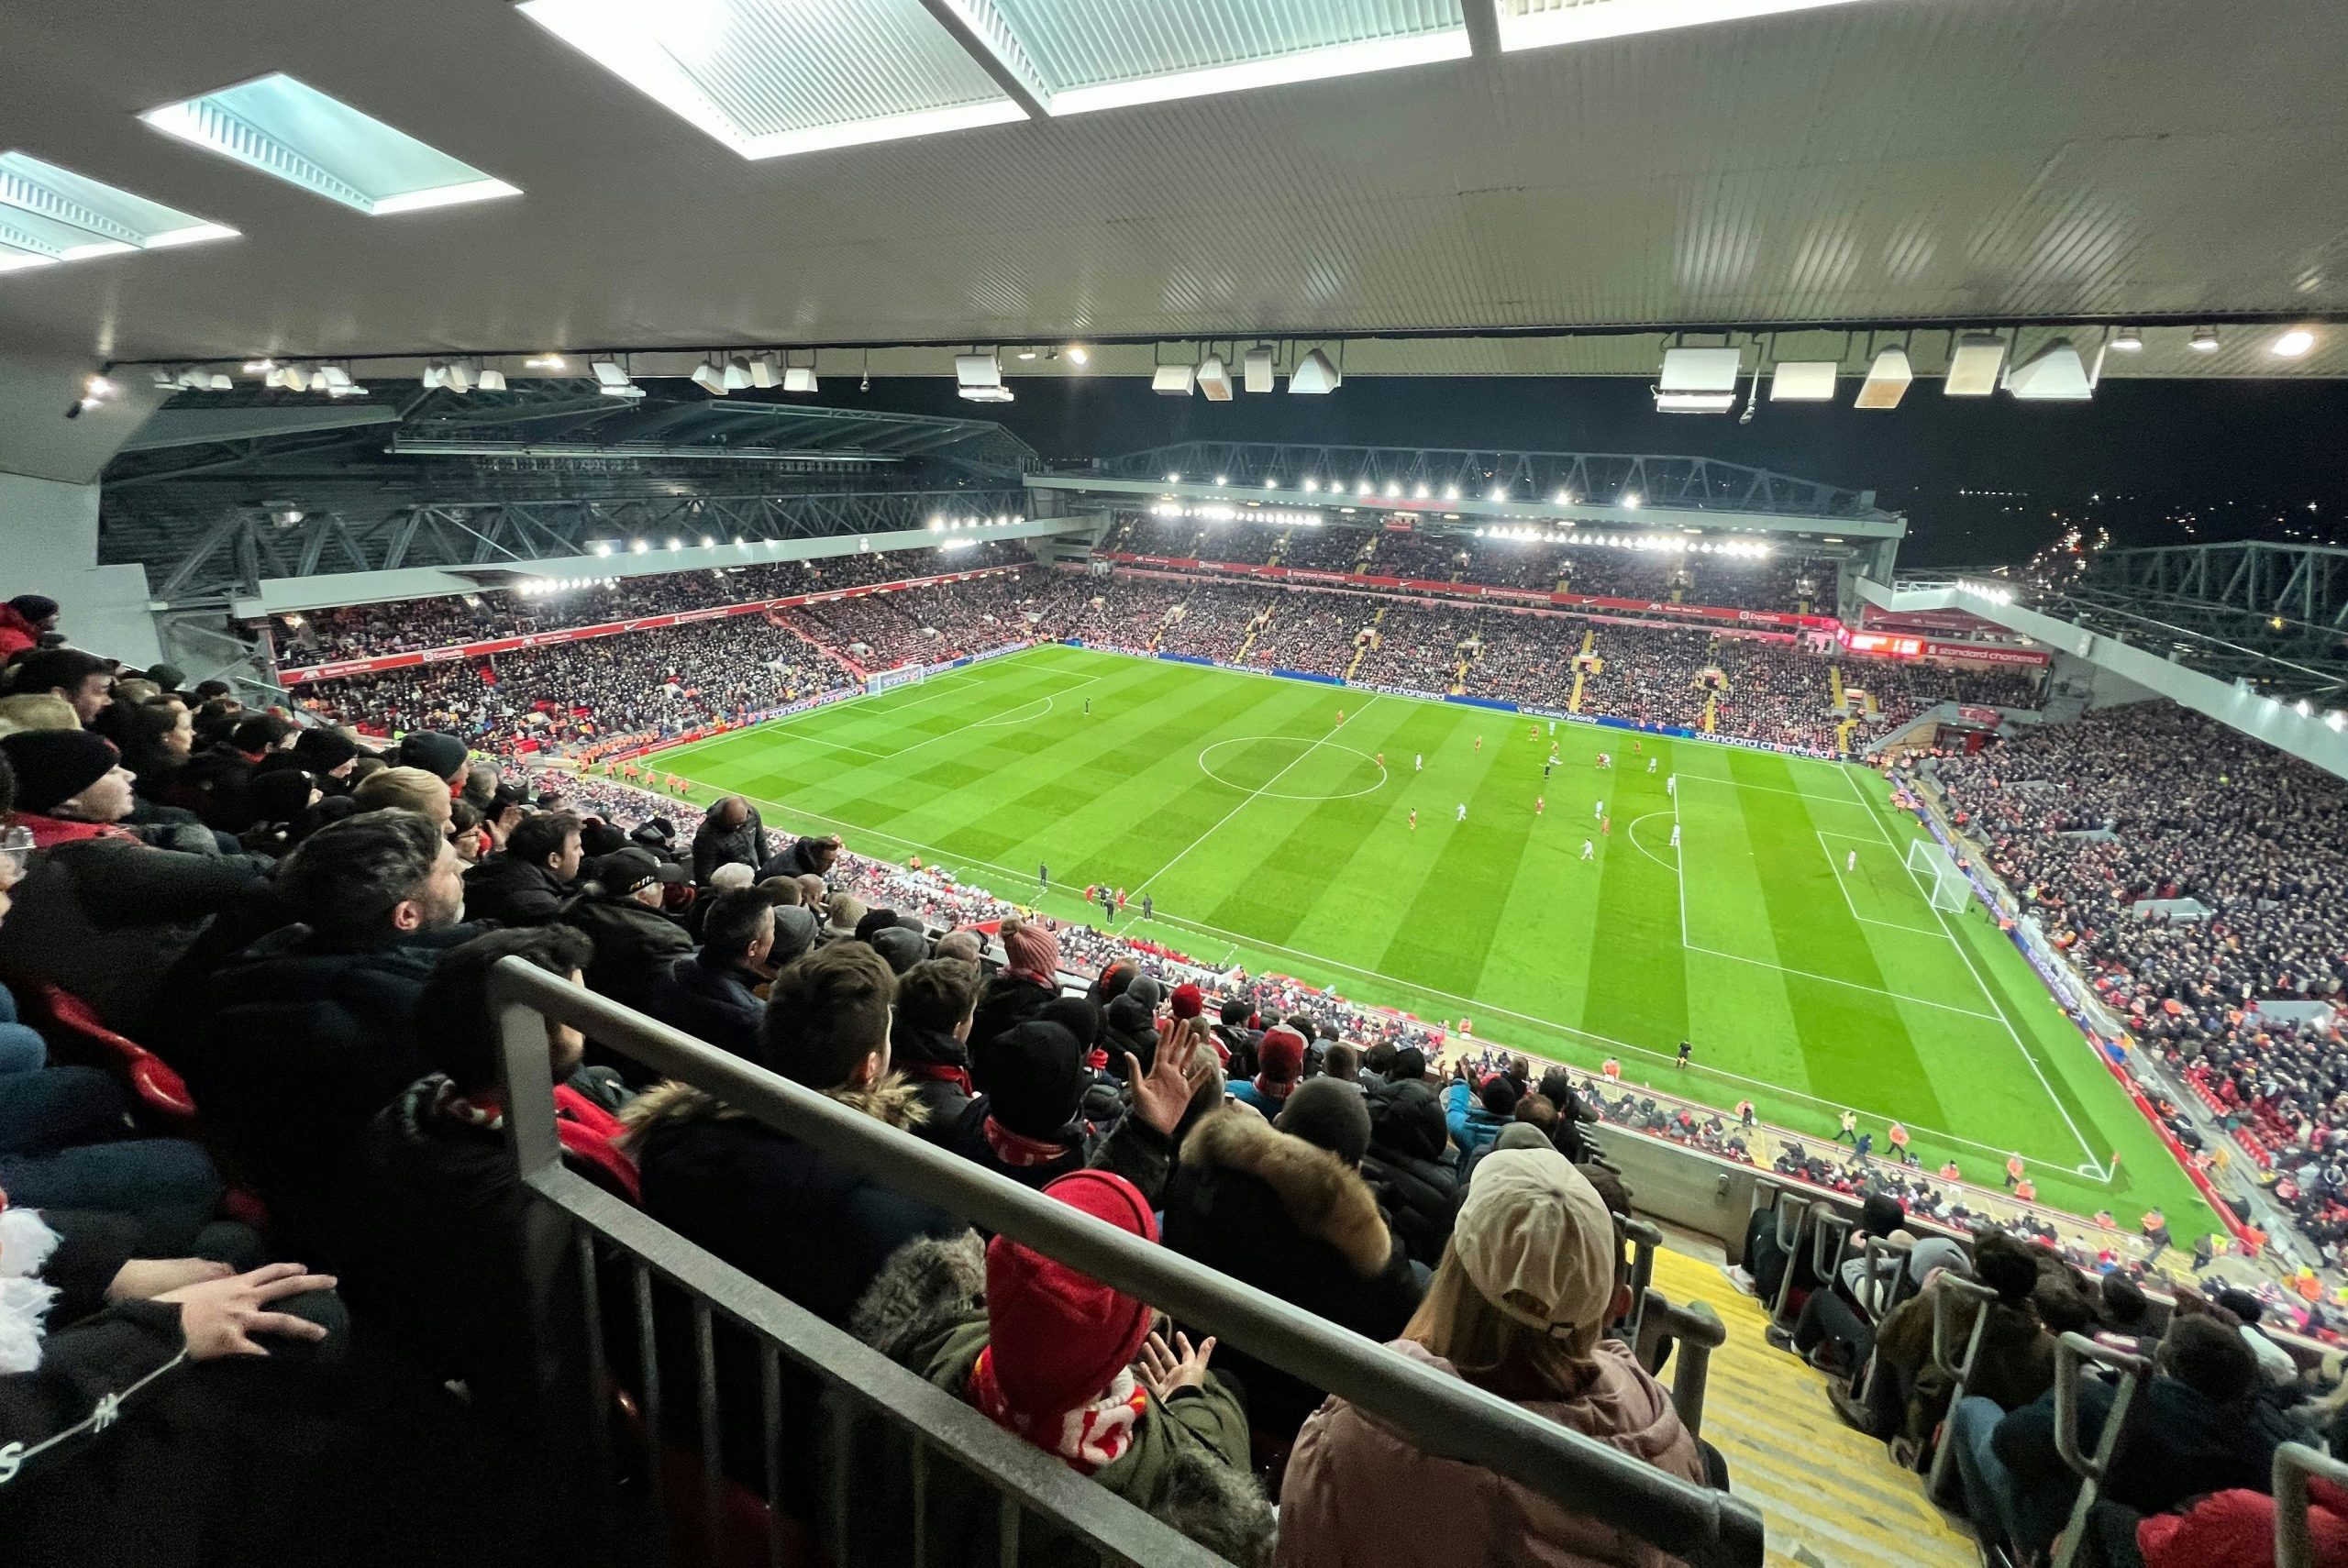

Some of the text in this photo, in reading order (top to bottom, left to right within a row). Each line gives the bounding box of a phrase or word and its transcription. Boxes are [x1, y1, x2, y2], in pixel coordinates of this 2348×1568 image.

[1939, 646, 2043, 664] standard chartered
[1392, 685, 1445, 701] chartered
[1695, 731, 1758, 748] standard
